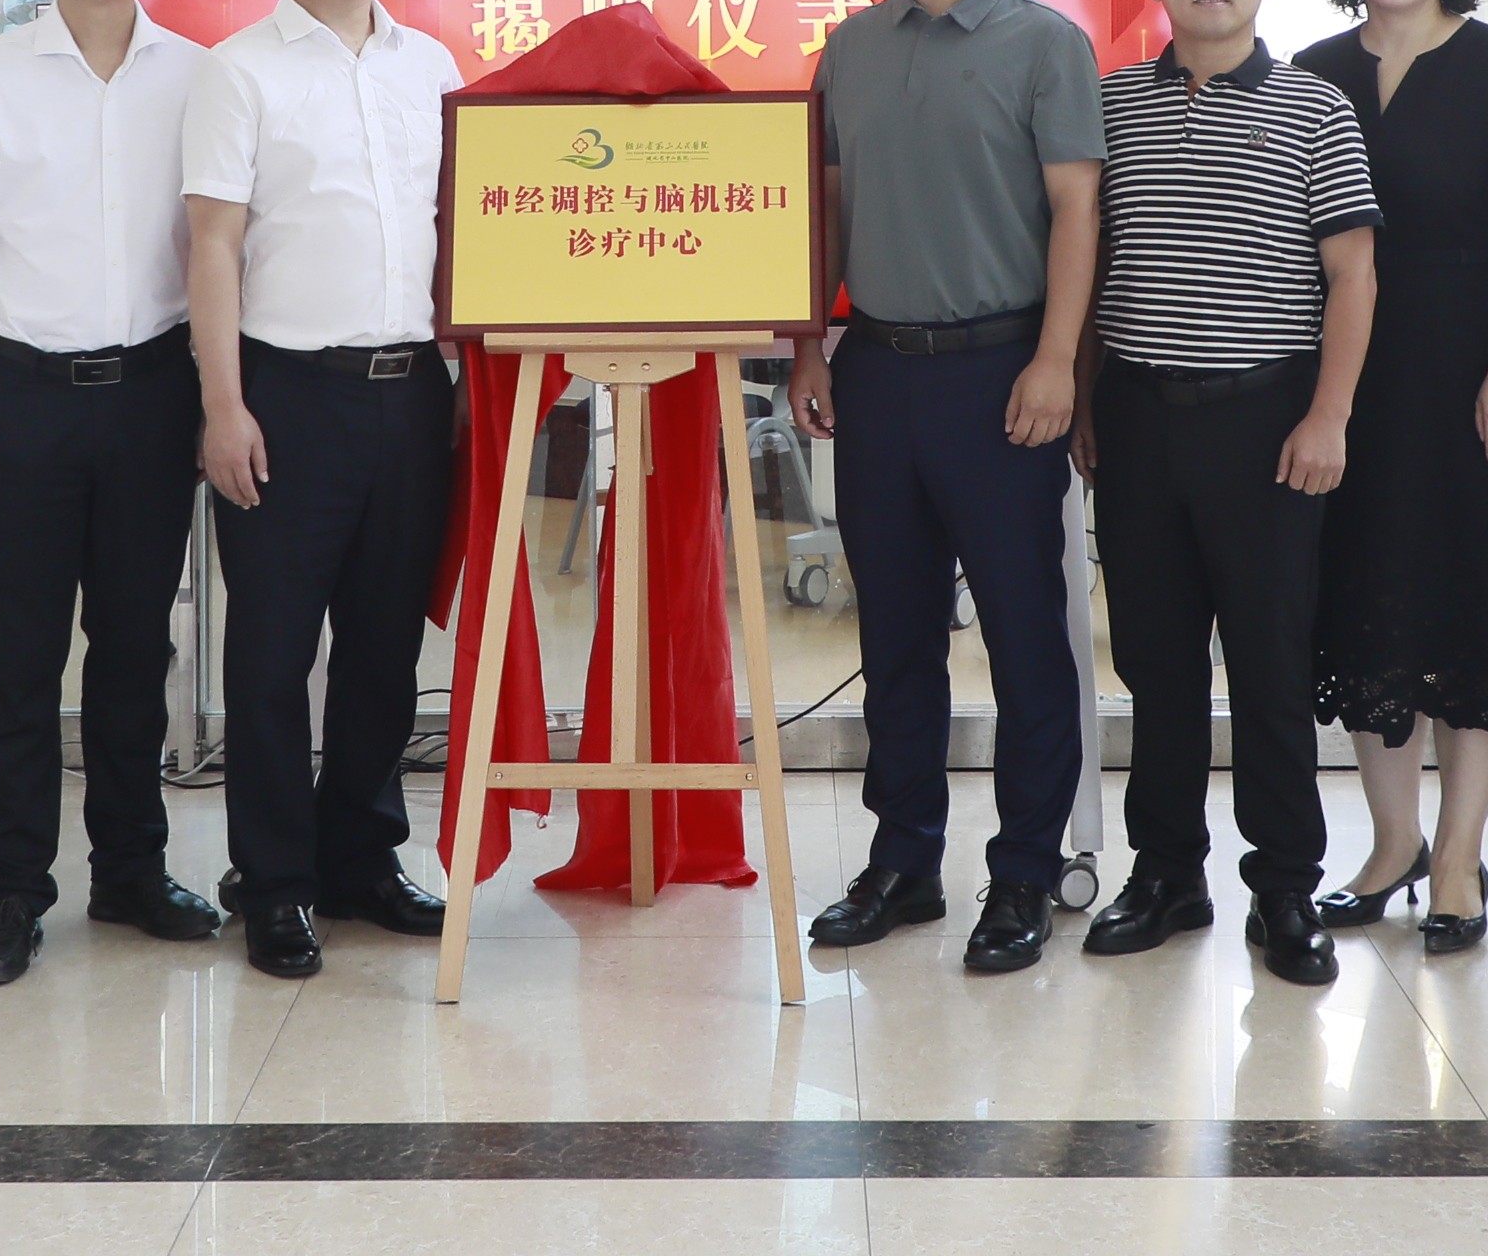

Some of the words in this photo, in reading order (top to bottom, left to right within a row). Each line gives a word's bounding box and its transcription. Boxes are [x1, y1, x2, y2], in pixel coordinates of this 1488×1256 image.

[478, 182, 788, 216] 神经调控与脑机接口
[566, 226, 703, 258] 诊疗中心
